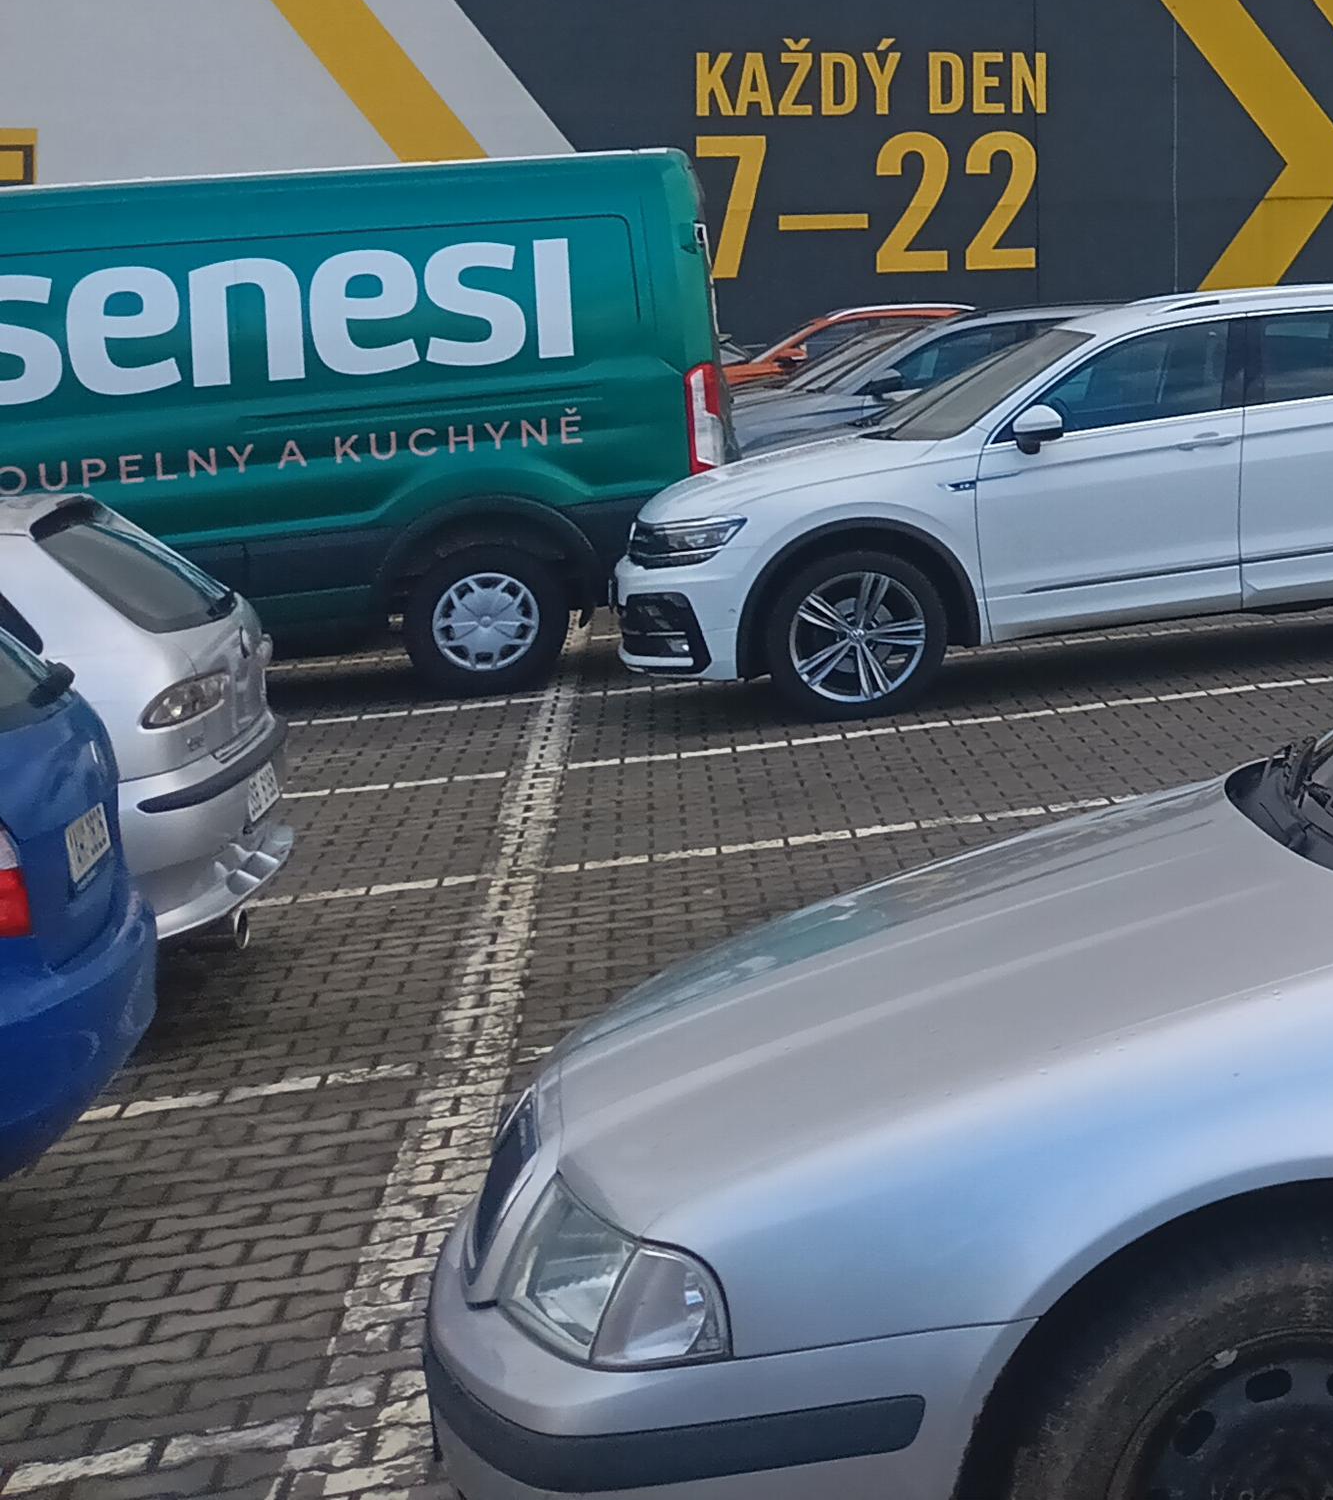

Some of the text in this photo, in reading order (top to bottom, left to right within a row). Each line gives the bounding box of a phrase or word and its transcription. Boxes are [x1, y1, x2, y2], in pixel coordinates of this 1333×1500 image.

[696, 38, 1047, 117] KAŽDÝ DEN
[277, 440, 307, 470] A
[333, 407, 584, 465] KUCHYNĚ
